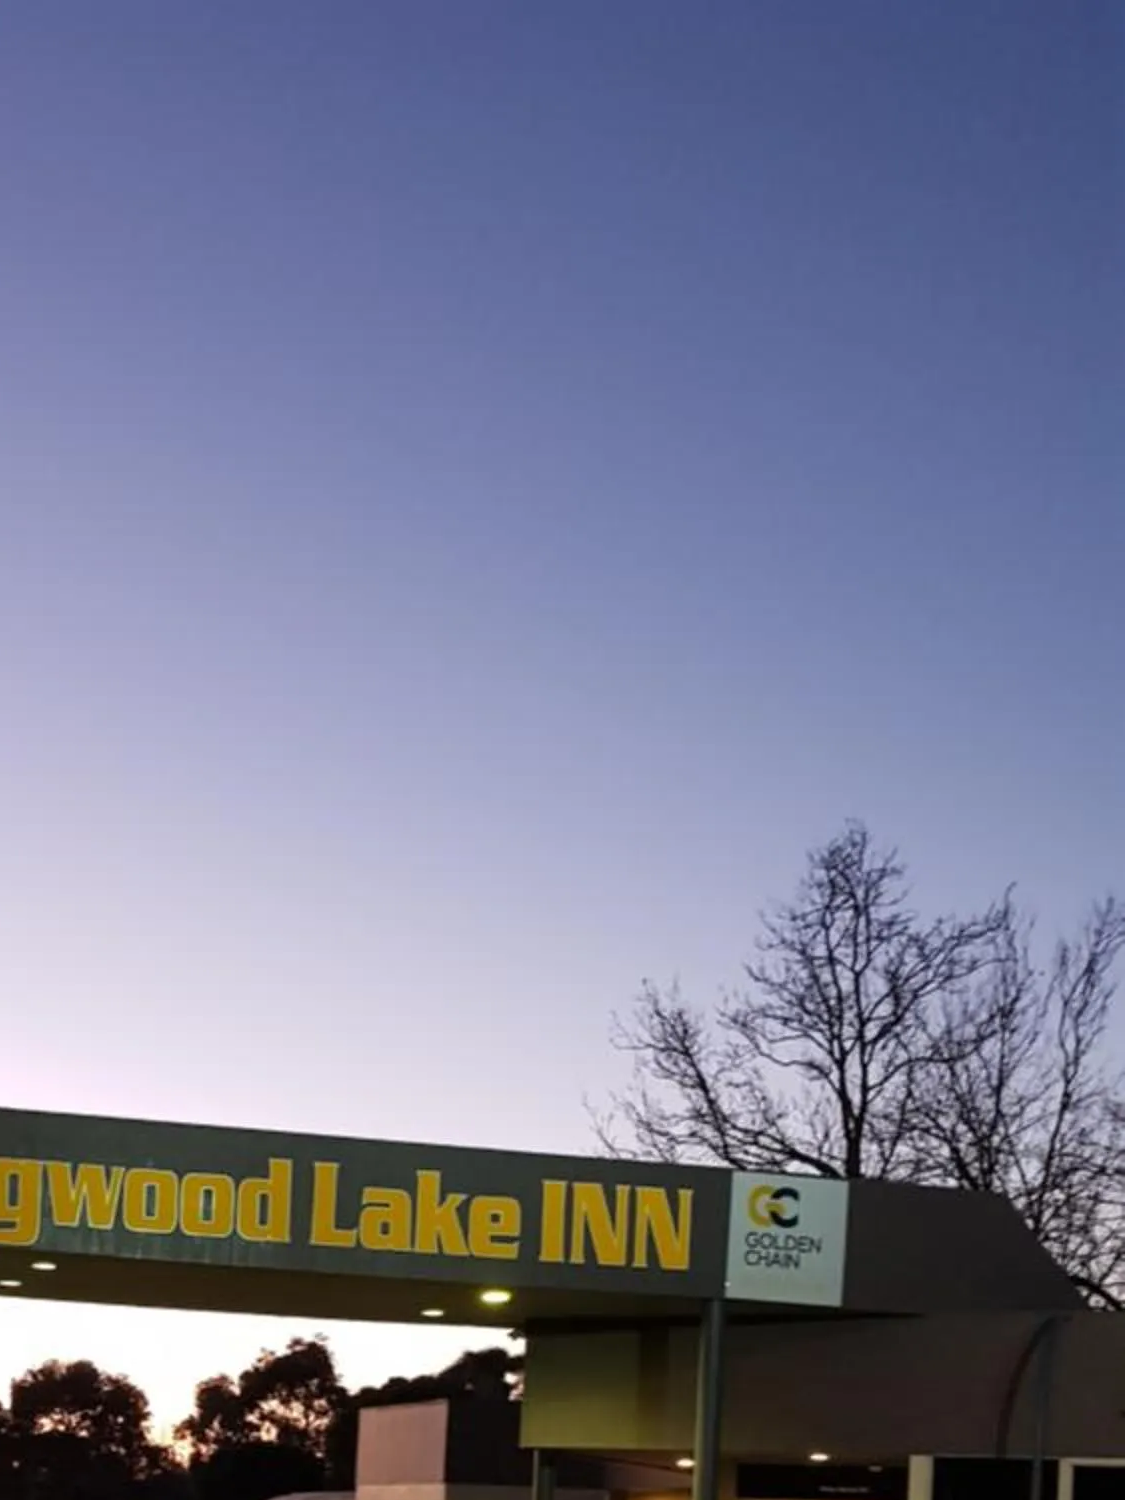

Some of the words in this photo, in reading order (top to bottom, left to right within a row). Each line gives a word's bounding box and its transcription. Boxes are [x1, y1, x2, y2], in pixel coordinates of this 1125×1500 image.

[310, 1160, 522, 1259] Lake
[538, 1178, 694, 1271] INN
[745, 1231, 822, 1254] GOLDEN
[744, 1249, 801, 1269] CHAIN
